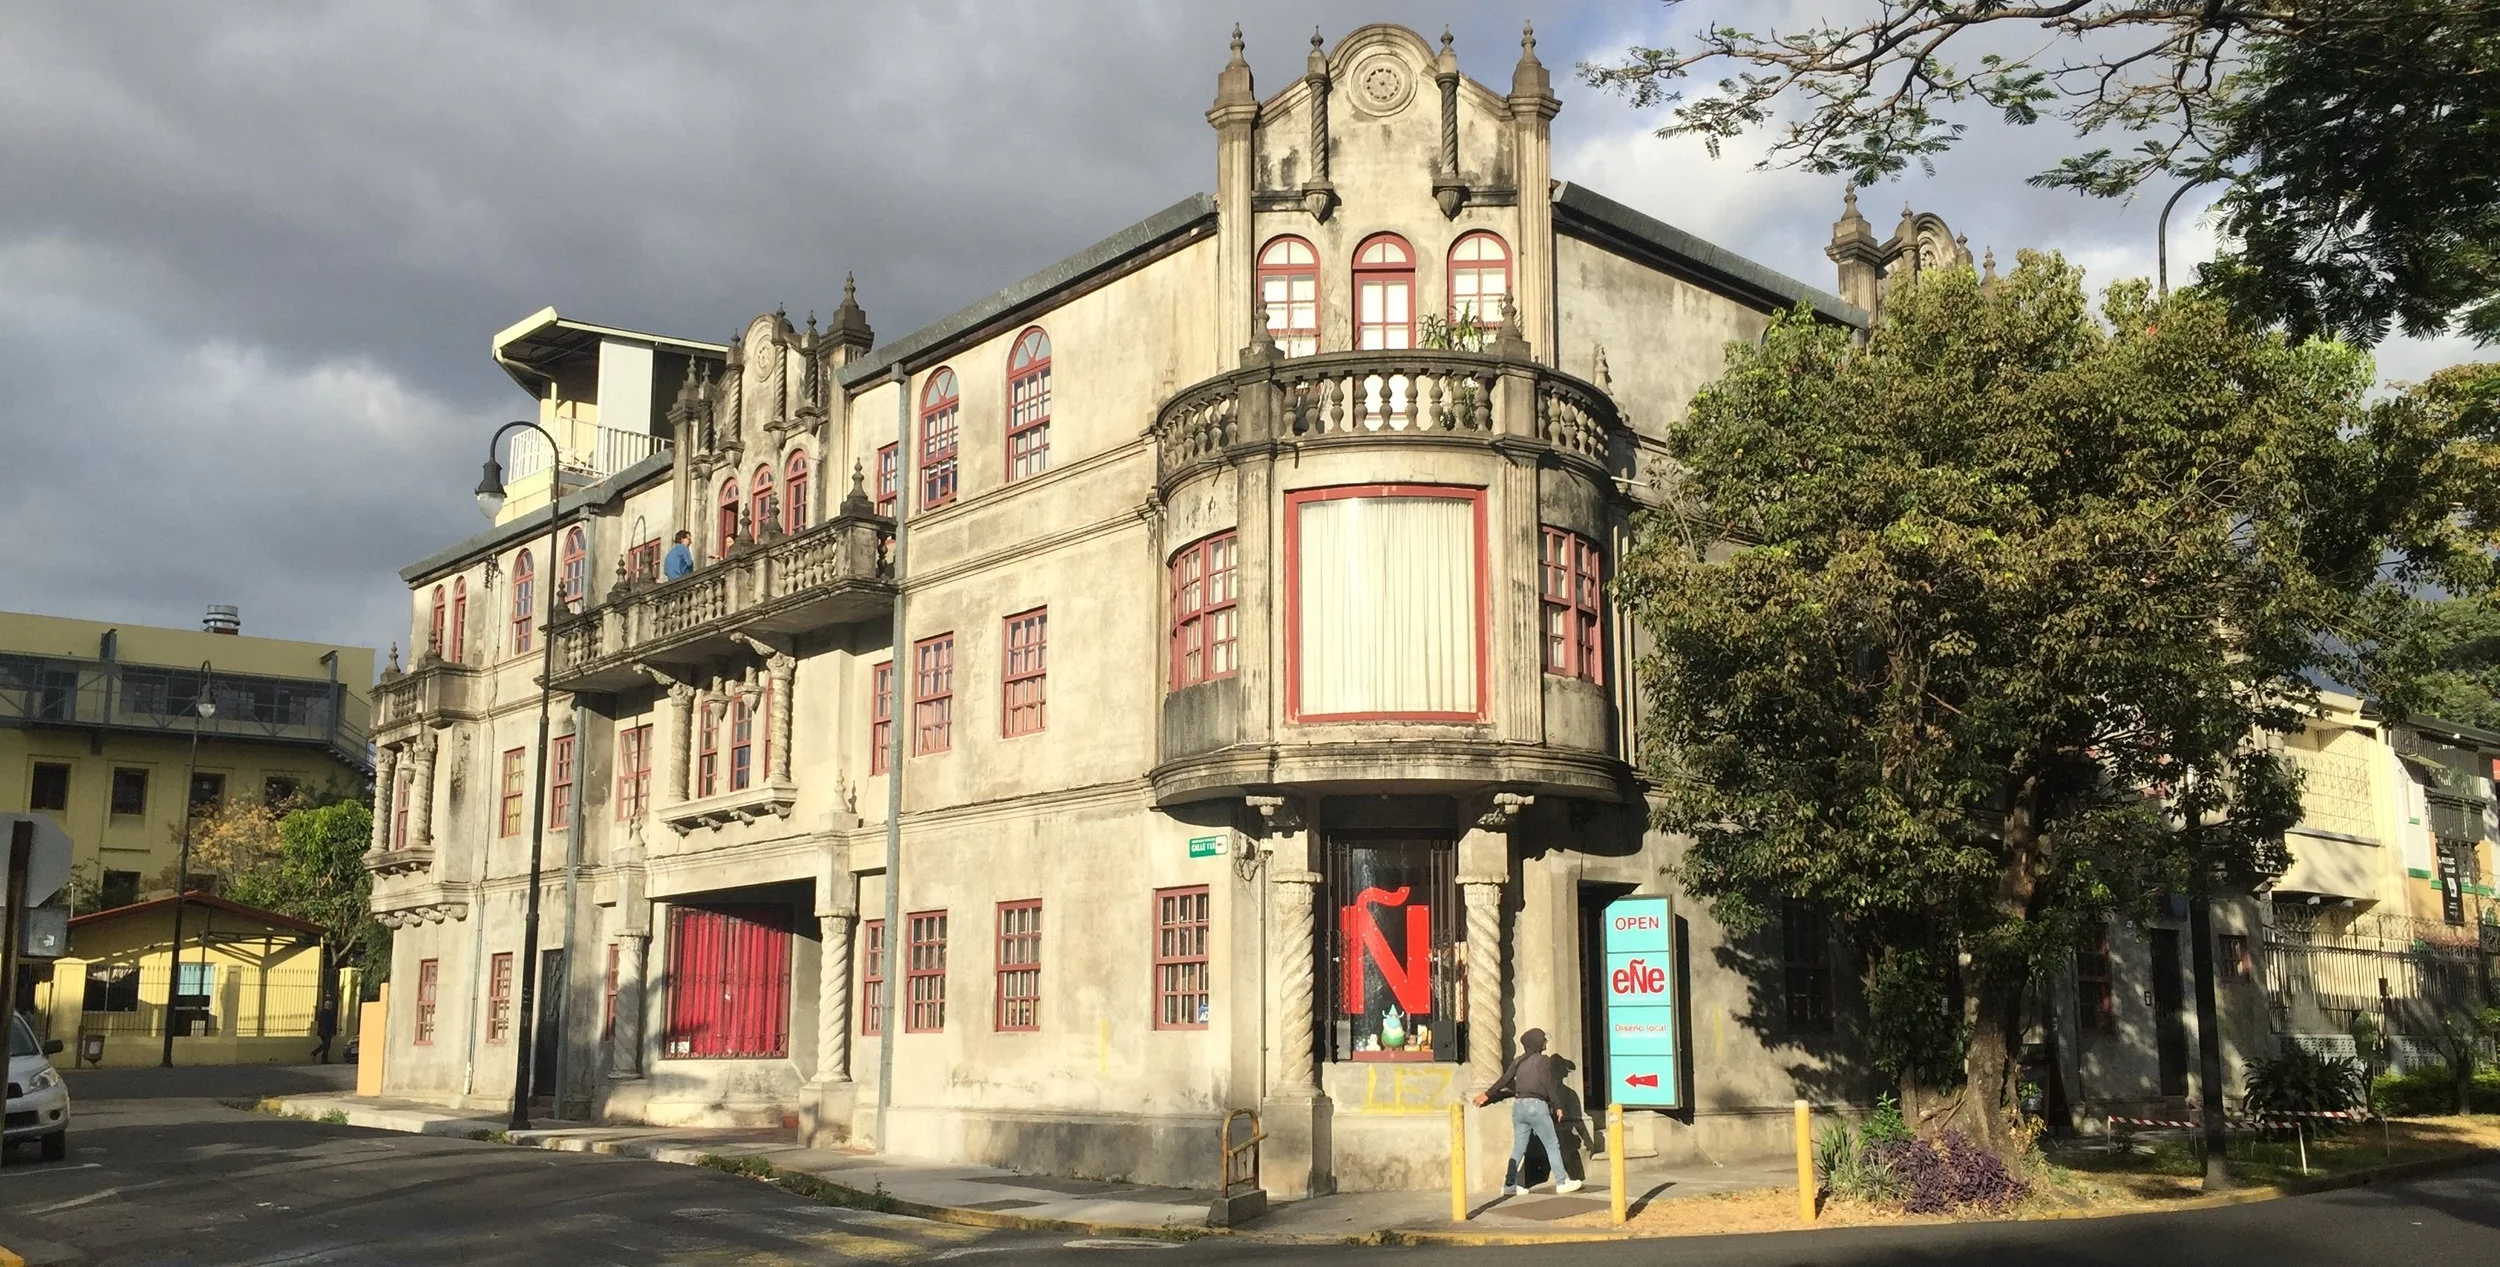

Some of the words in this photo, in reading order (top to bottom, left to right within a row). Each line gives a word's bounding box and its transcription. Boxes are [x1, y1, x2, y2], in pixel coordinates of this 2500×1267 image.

[1615, 916, 1659, 930] OPEN
[1341, 886, 1431, 1014] Ñ
[1612, 959, 1666, 994] eÑe
